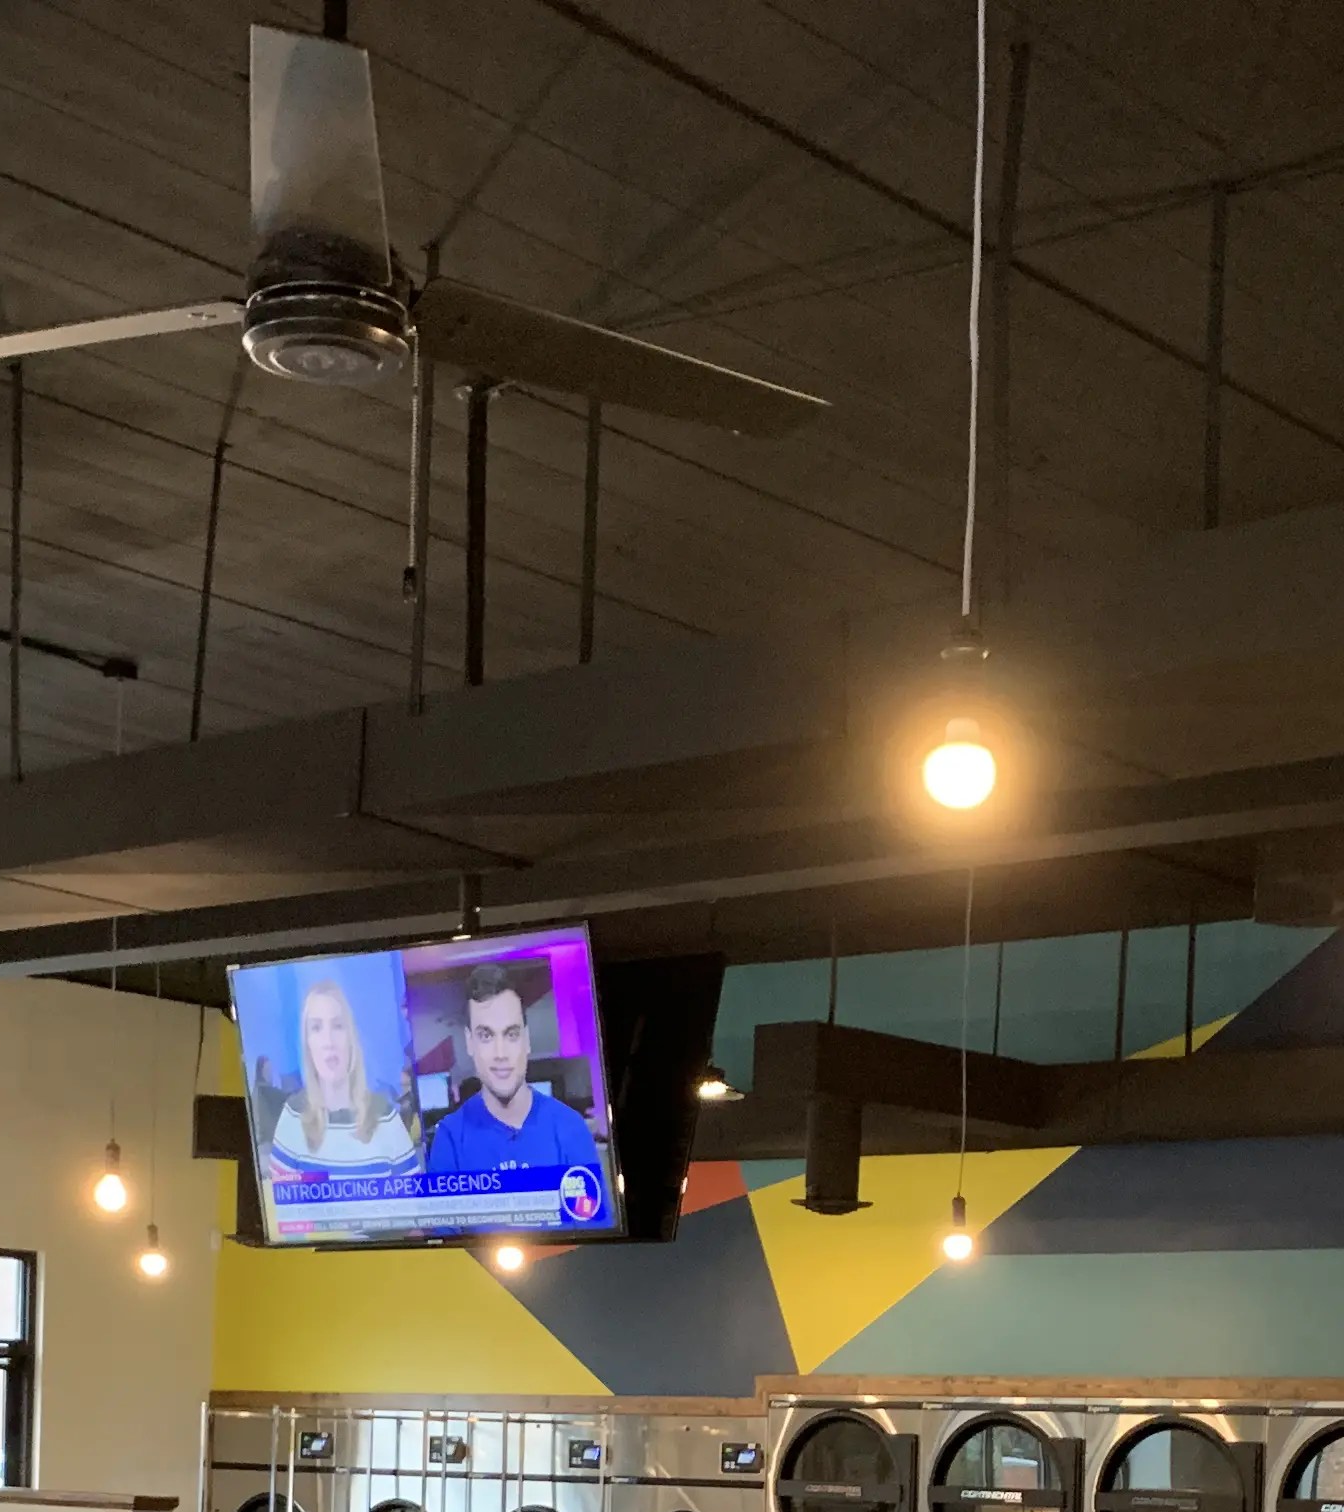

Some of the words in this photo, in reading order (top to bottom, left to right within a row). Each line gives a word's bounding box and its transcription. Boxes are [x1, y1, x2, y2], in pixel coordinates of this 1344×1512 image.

[276, 1179, 379, 1200] INTRODUCING
[383, 1177, 425, 1196] APEX
[428, 1173, 502, 1194] LEGENDS
